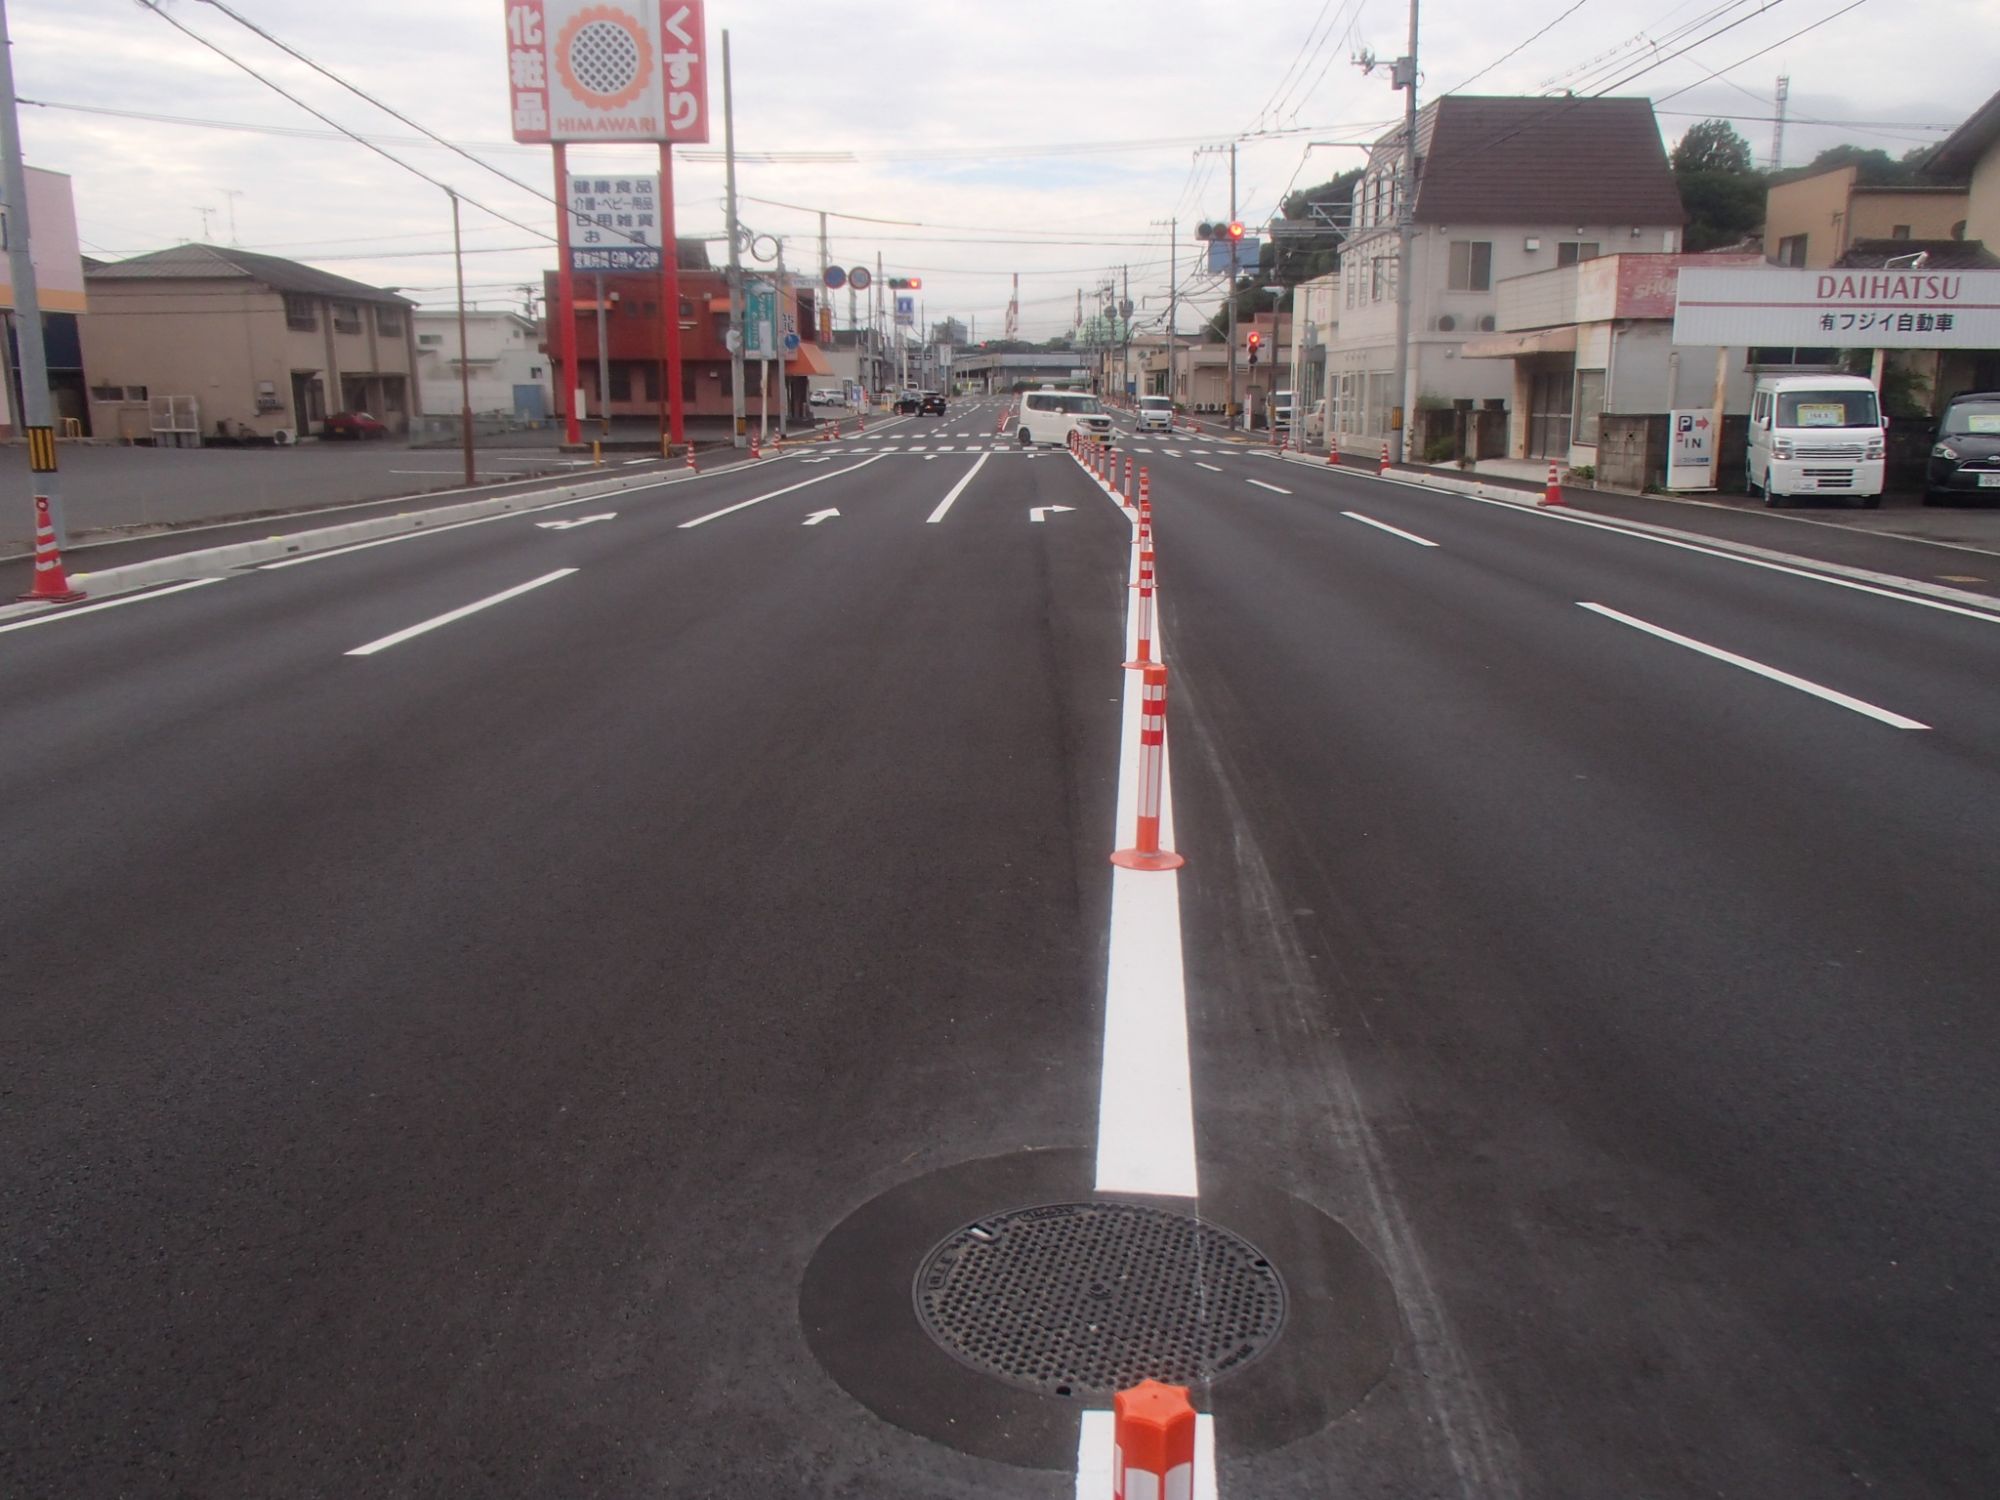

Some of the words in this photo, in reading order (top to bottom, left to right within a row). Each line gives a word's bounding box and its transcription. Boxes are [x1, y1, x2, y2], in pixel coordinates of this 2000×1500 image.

[508, 5, 547, 131] 化粧品
[663, 5, 699, 131] くすり
[557, 117, 657, 132] HIMAWARI
[574, 180, 652, 193] 健康食品
[576, 213, 654, 227] 日用雑貨
[1816, 275, 1960, 299] DAIHATSU
[1685, 438, 1702, 448] IN
